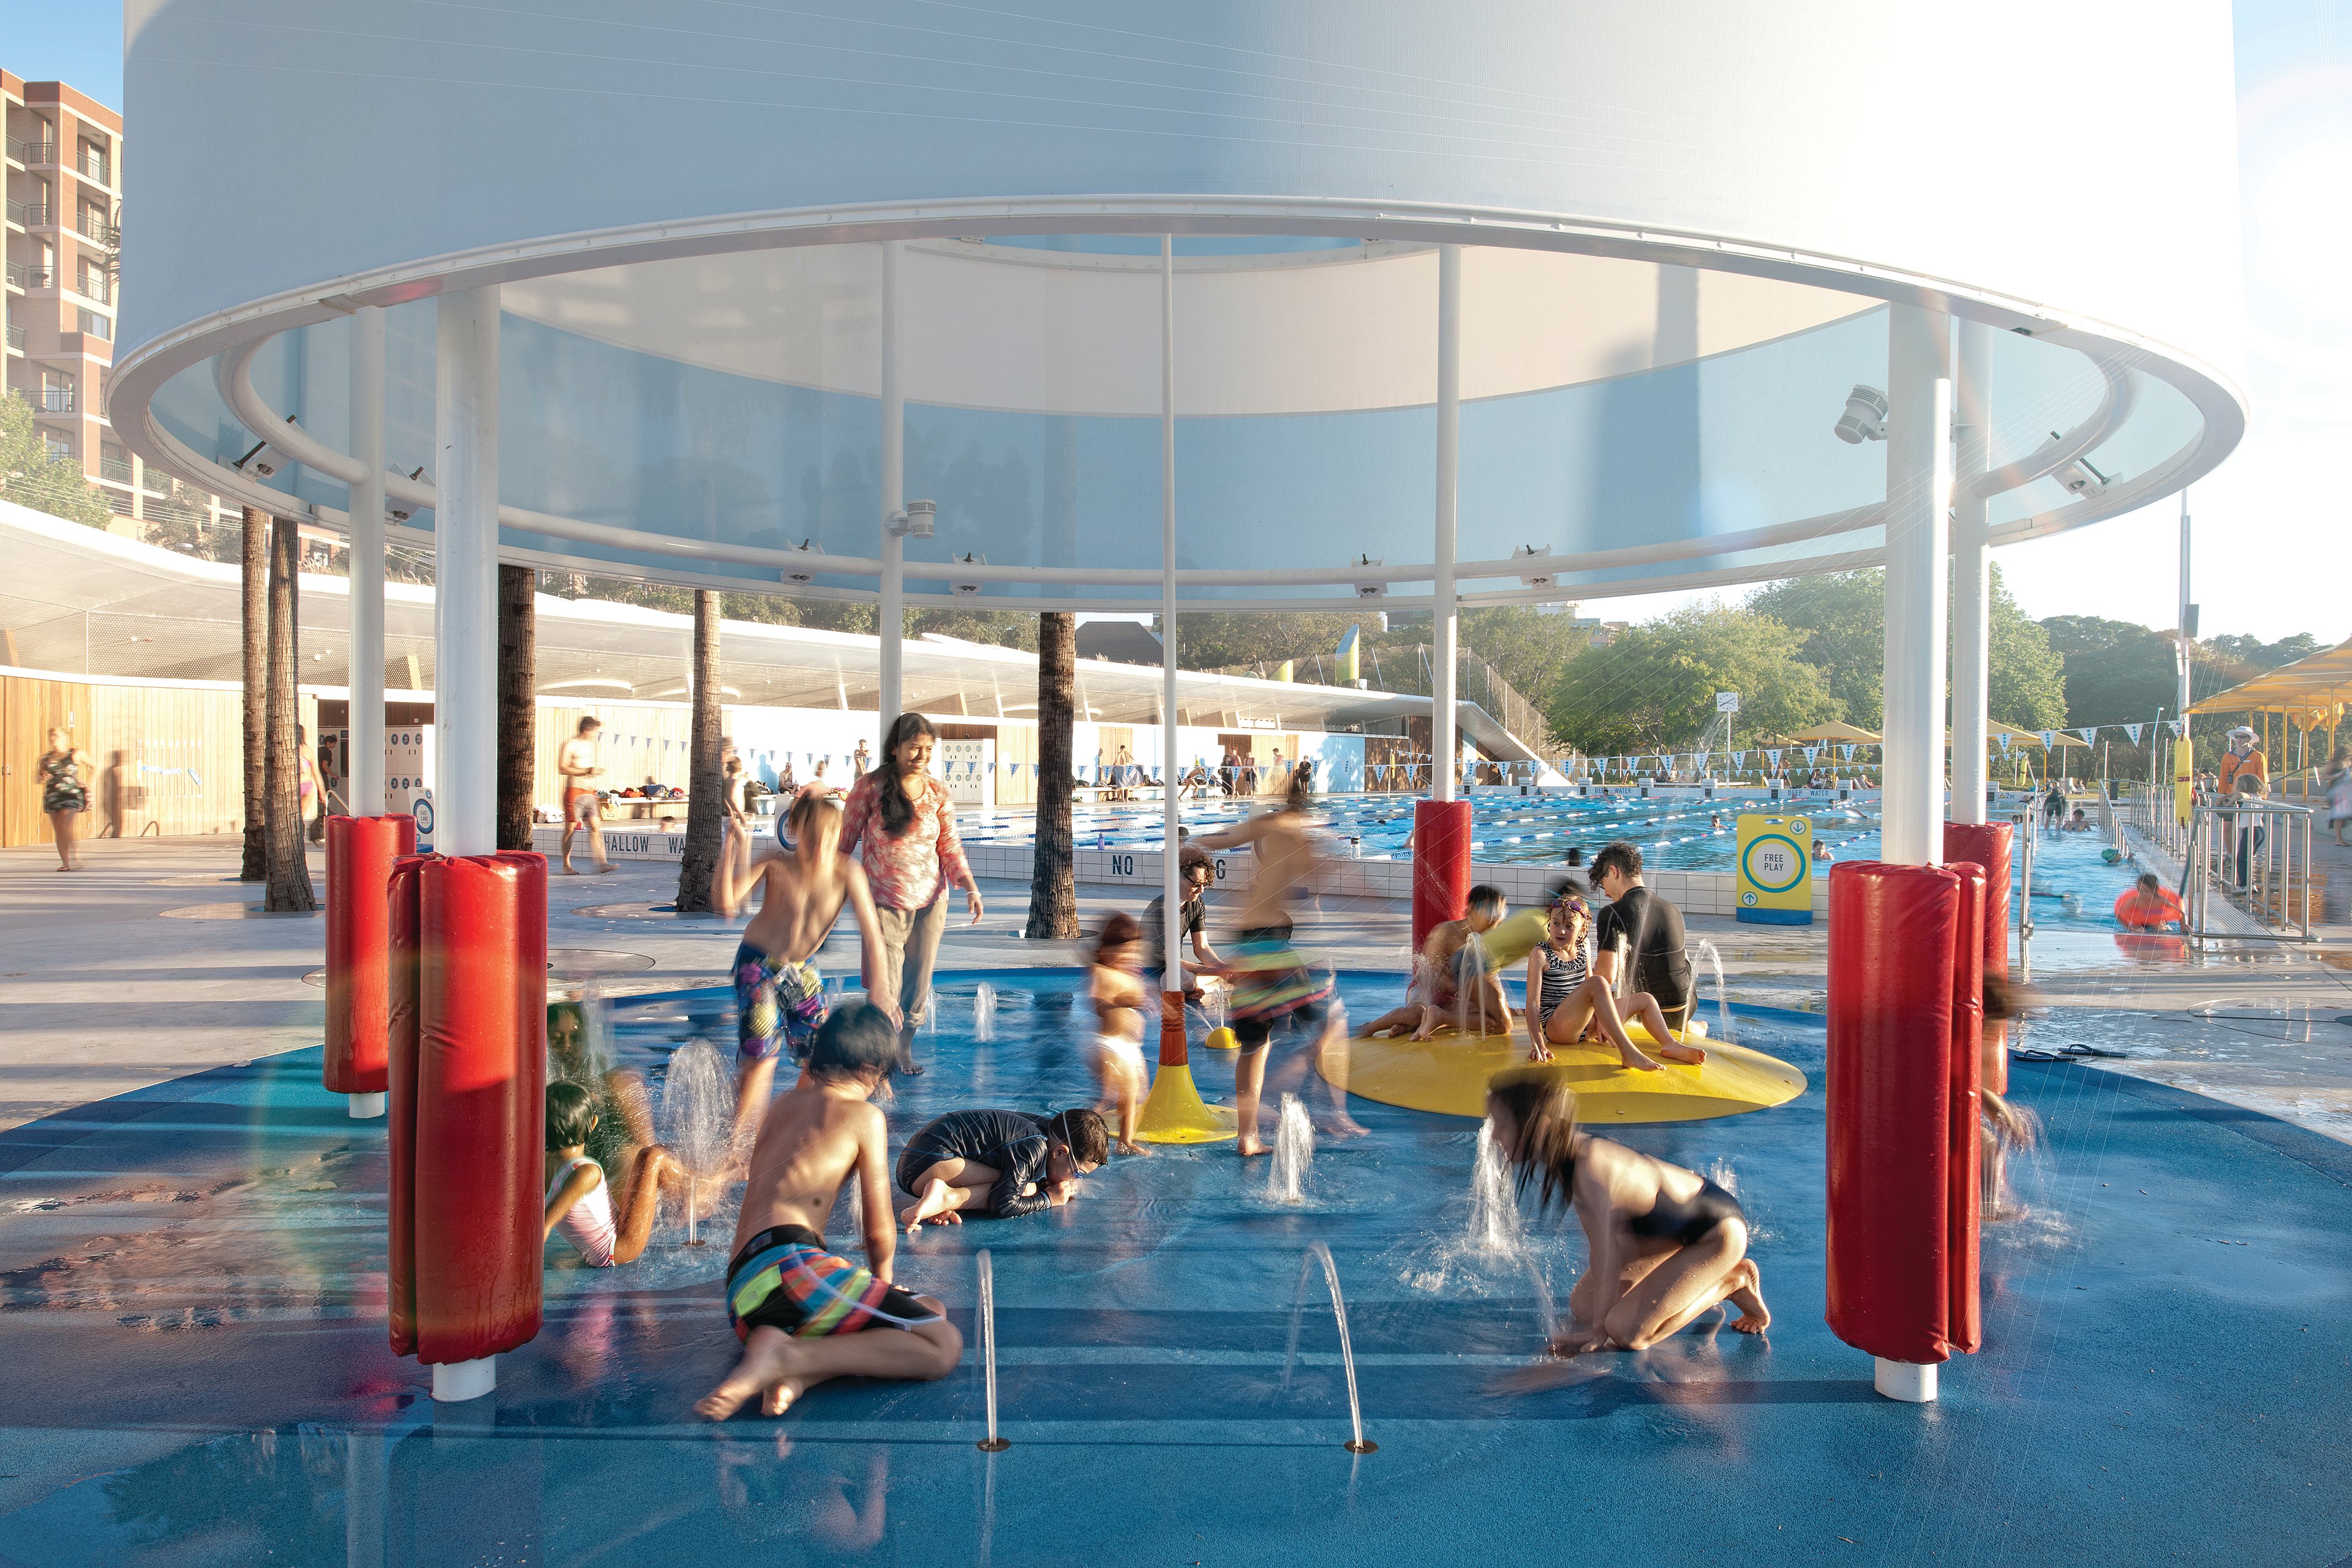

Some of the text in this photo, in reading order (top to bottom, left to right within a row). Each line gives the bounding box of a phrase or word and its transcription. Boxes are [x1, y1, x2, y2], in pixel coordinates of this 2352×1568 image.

[604, 835, 649, 853] HALLOW
[1112, 854, 1133, 875] NO
[1765, 854, 1784, 862] FREE
[1765, 862, 1784, 871] PLAY
